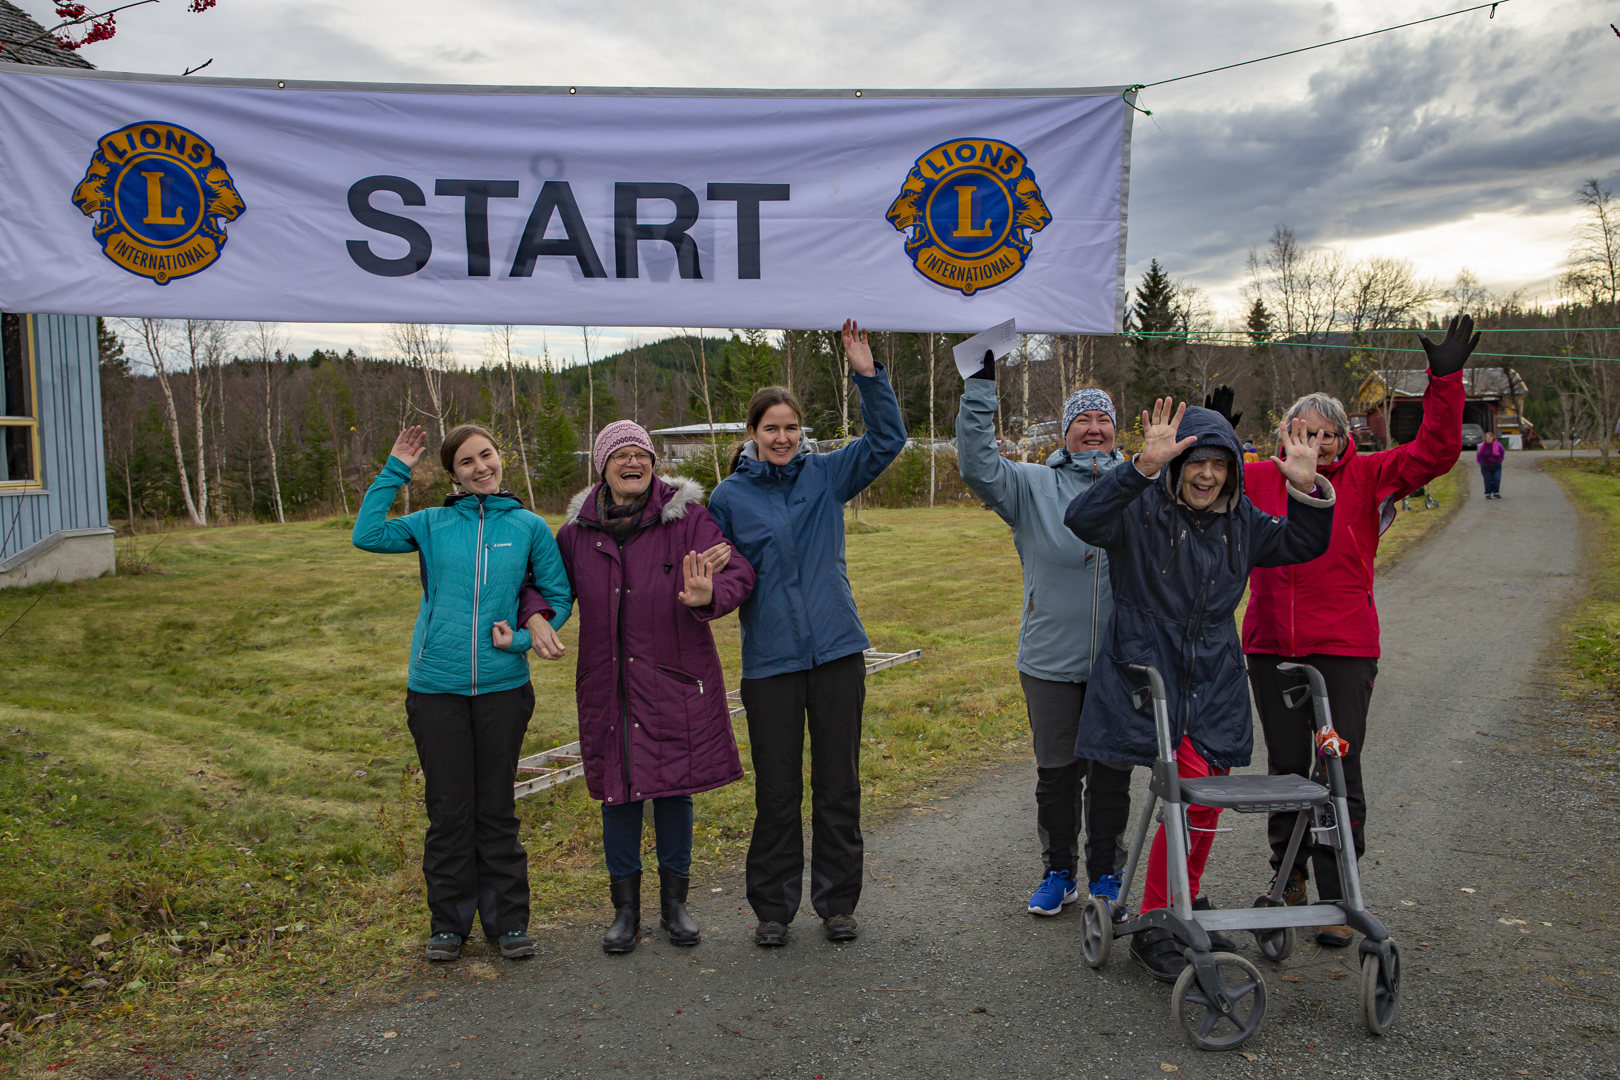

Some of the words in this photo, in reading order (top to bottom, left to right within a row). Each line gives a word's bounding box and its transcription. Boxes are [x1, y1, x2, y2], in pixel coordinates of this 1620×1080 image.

[106, 127, 207, 164] LIONS
[925, 143, 1018, 175] LIONS
[141, 171, 185, 225] L
[953, 185, 993, 237] L
[345, 174, 791, 280] START
[112, 239, 210, 271] INTERNATIONAL
[923, 252, 1016, 282] INTERNATIONAL
